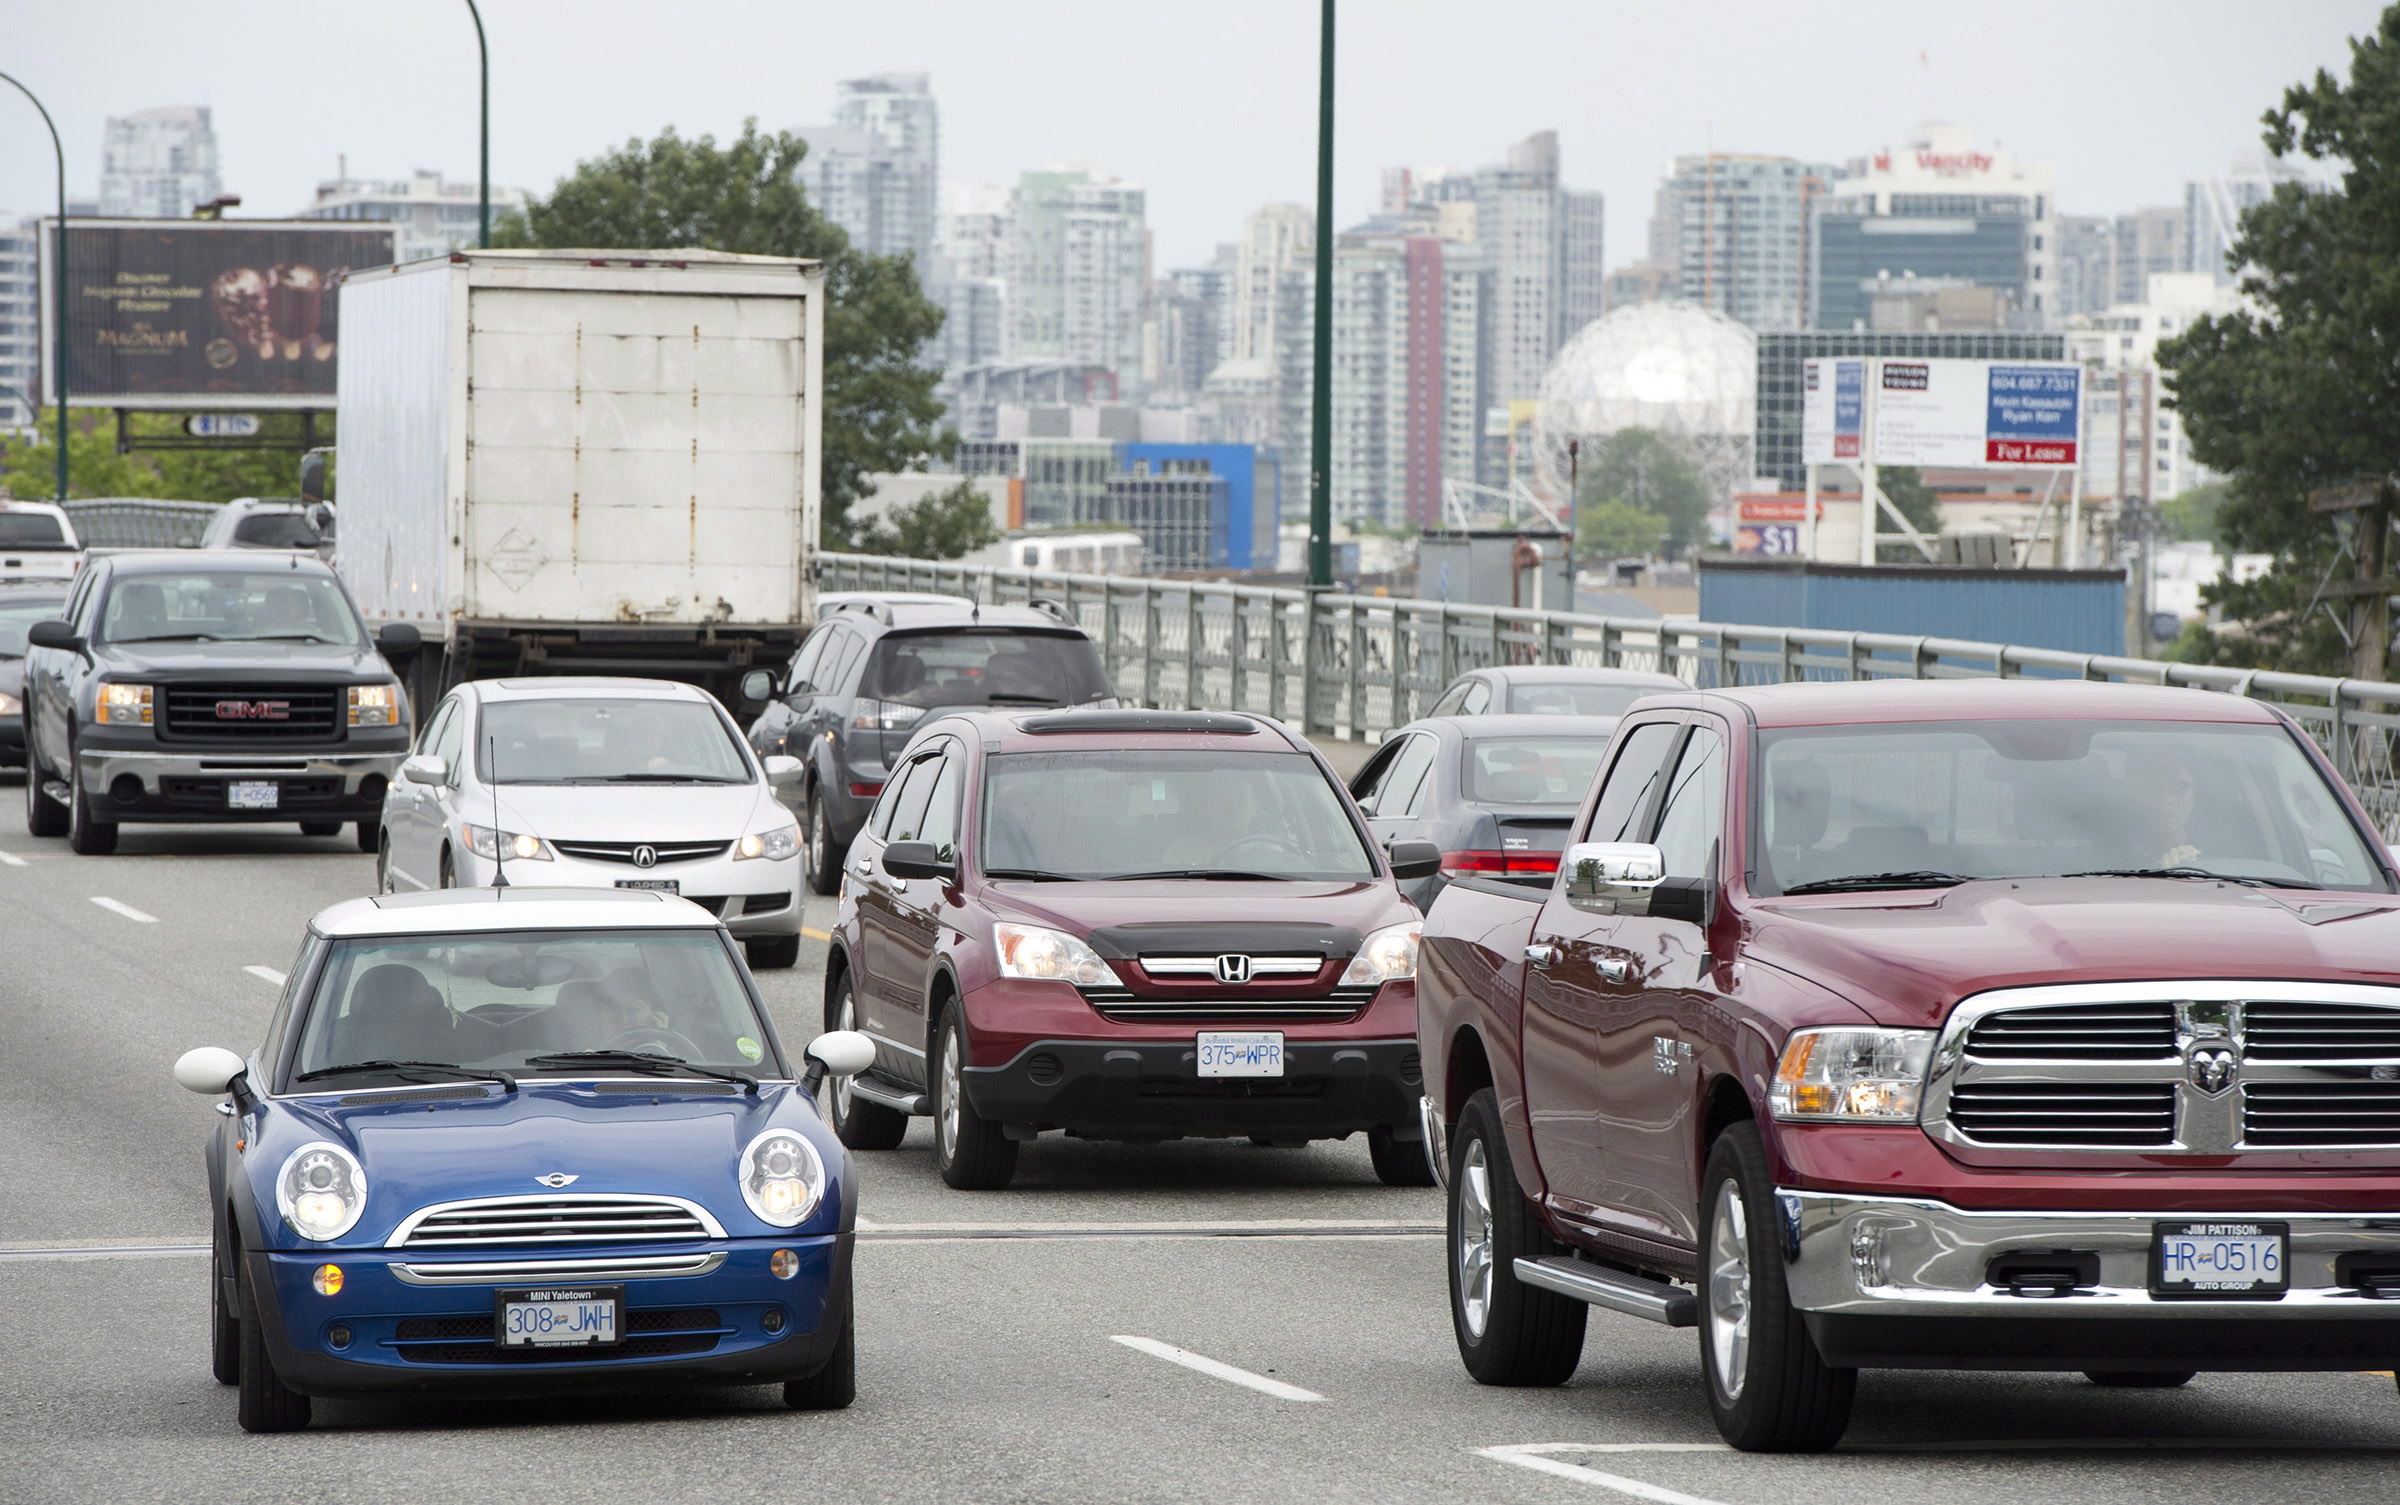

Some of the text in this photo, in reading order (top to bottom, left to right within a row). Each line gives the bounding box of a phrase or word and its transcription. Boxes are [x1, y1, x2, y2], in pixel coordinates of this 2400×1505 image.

[1997, 443, 2066, 461] For Lease
[216, 701, 290, 718] GMC
[1201, 1045, 1280, 1065] 375 WPR
[2188, 1225, 2257, 1235] JIM PATTISON
[2163, 1242, 2279, 1271] HR 0516
[2193, 1282, 2254, 1290] AUTO GROUP
[530, 1291, 591, 1301] MINI Yaletown
[508, 1305, 613, 1333] 308 JWH
